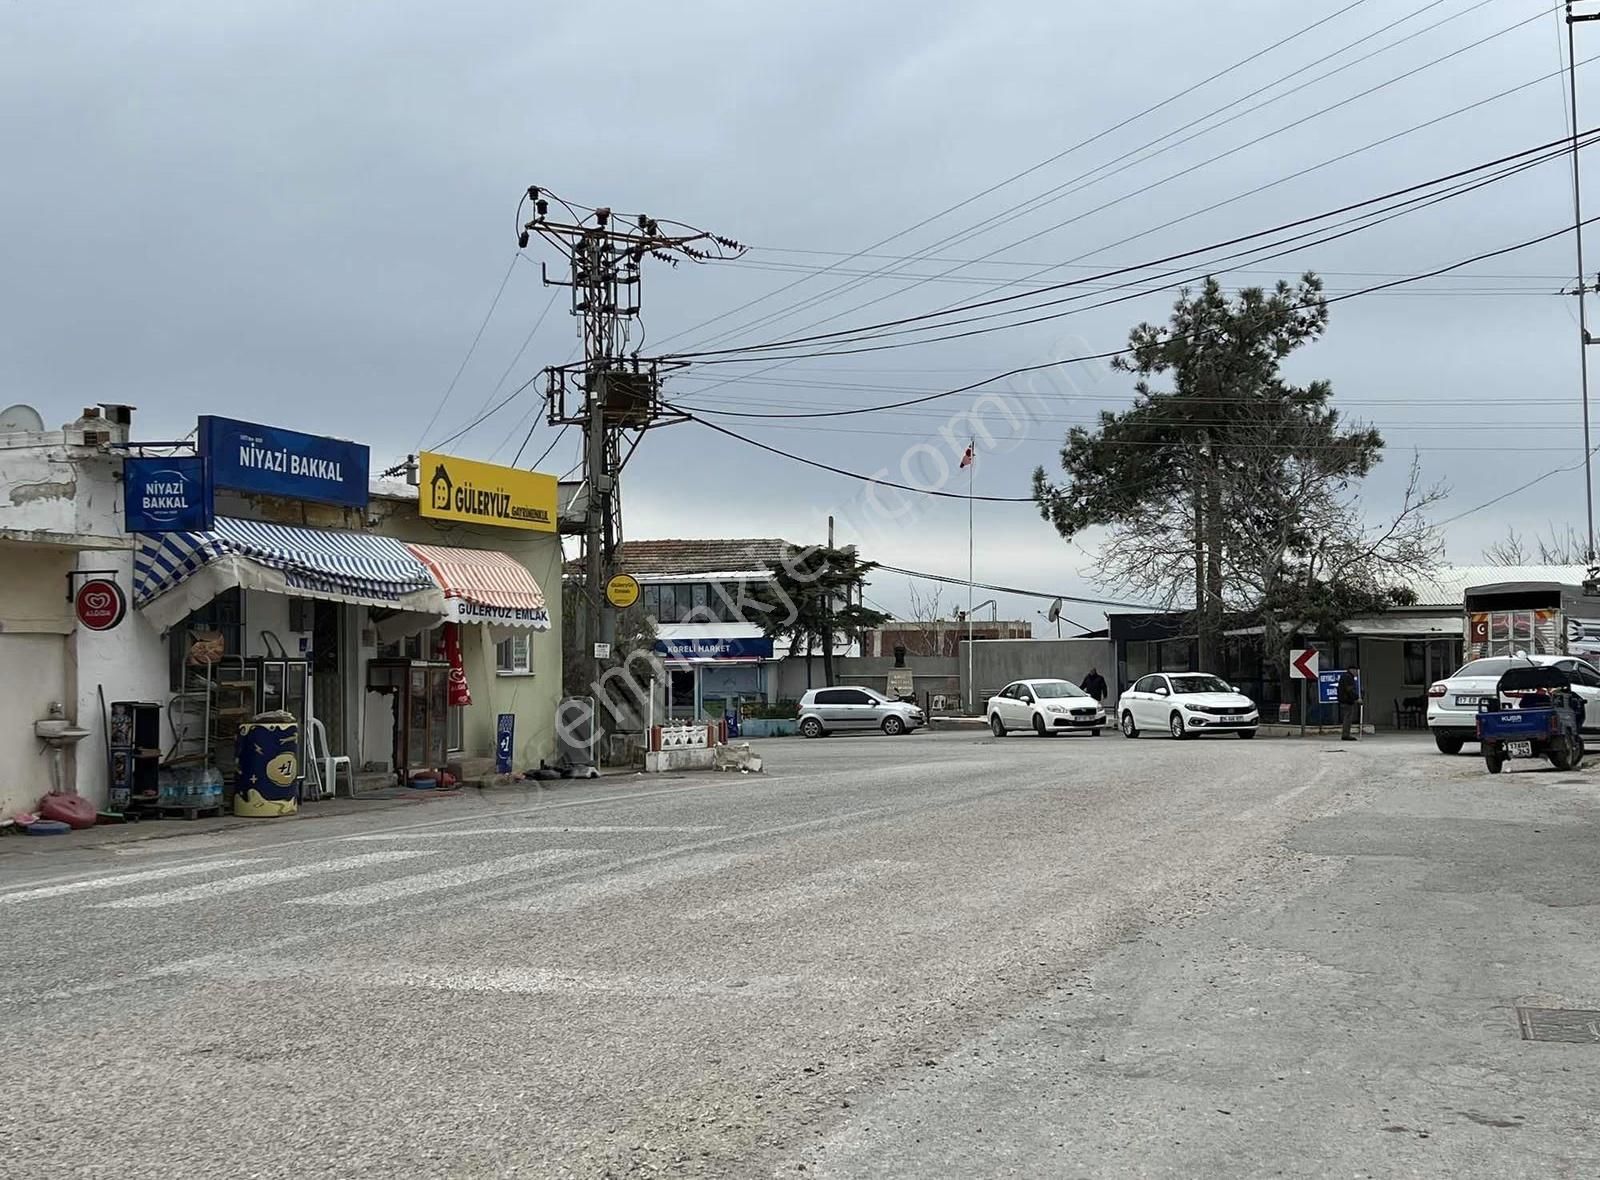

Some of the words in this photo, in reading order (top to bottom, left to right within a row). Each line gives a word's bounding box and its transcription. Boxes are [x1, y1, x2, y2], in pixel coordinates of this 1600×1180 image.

[240, 442, 287, 473] NİYAZİ
[291, 455, 344, 482] BAKKAL
[146, 480, 184, 495] NİYAZİ
[143, 497, 189, 509] BAKKAL
[455, 482, 511, 518] GÜLERYÜZ
[515, 609, 548, 621] EMLAK
[698, 645, 731, 653] MARKET
[500, 736, 509, 752] +1
[278, 760, 292, 776] +1
